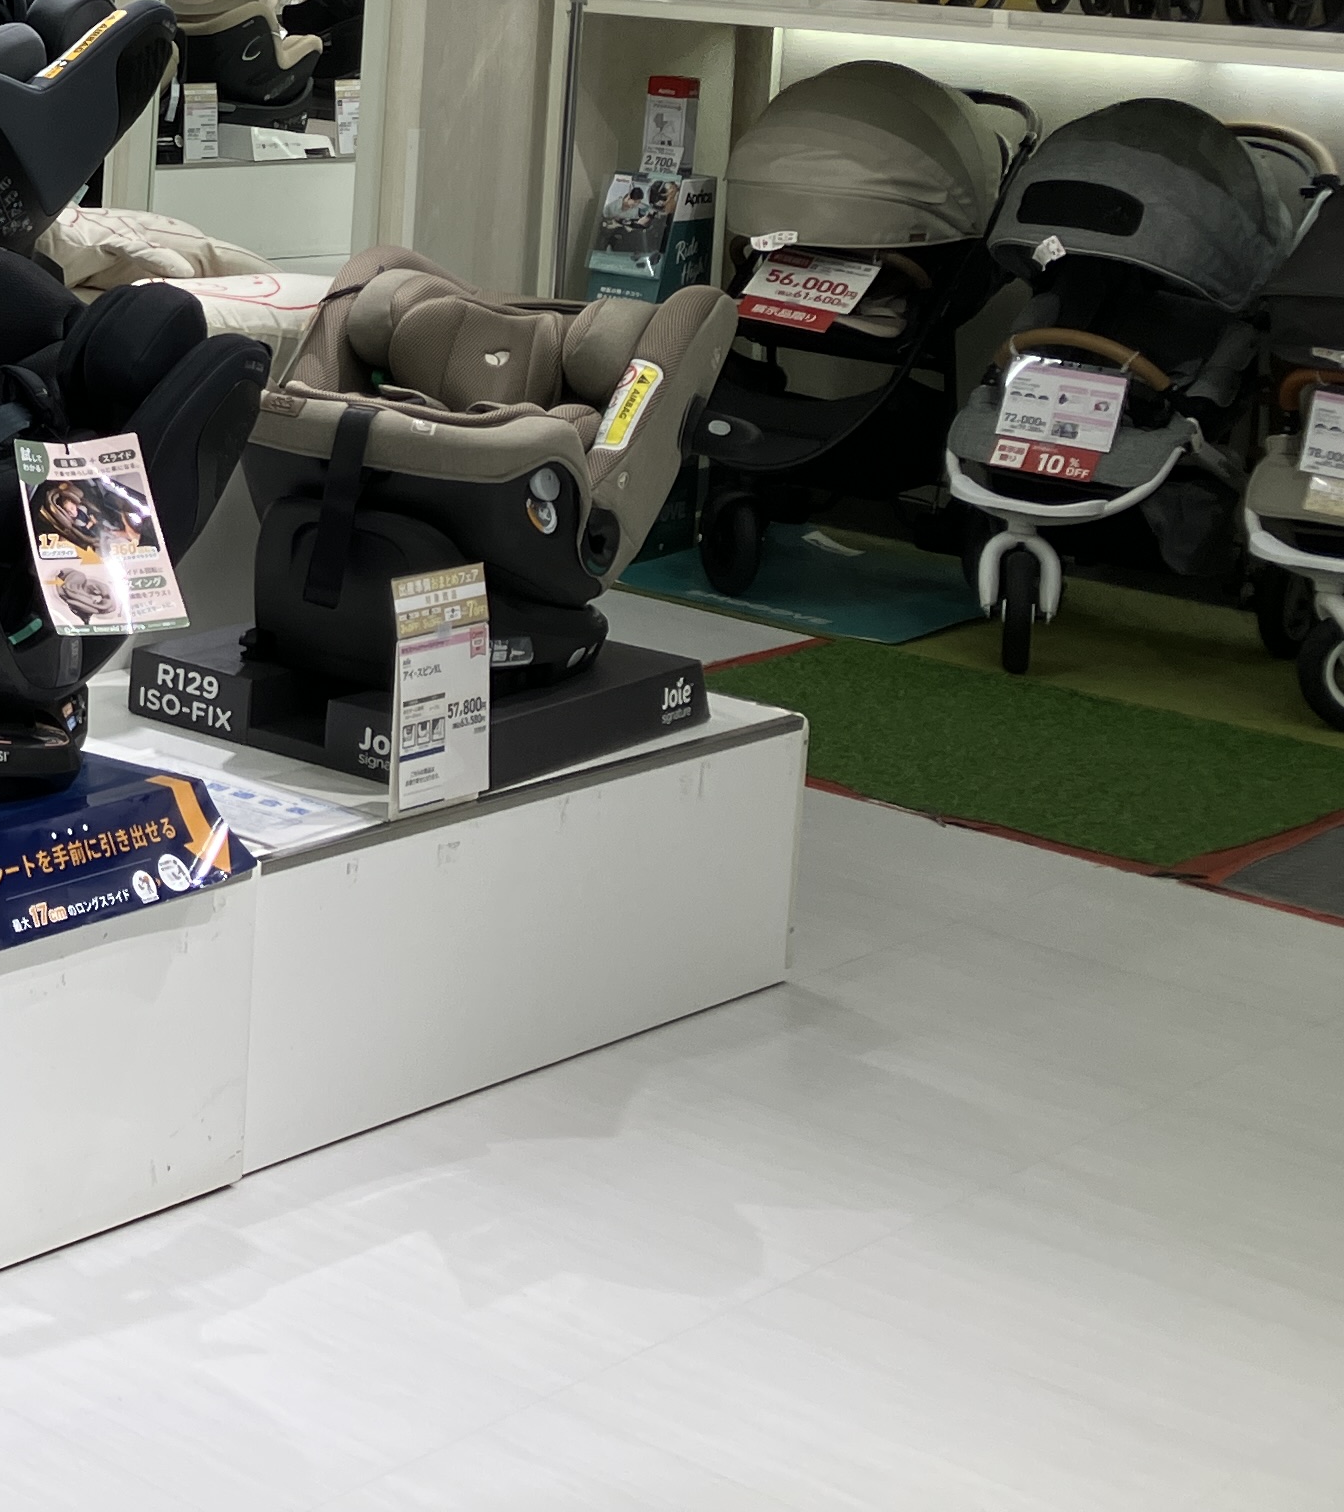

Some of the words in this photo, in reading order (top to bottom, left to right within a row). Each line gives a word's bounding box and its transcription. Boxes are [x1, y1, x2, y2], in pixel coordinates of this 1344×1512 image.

[765, 268, 859, 300] 56,000円
[619, 388, 641, 420] AIRBAG
[156, 661, 220, 701] R129
[662, 677, 693, 712] Joie
[138, 685, 232, 733] ISO-FIX
